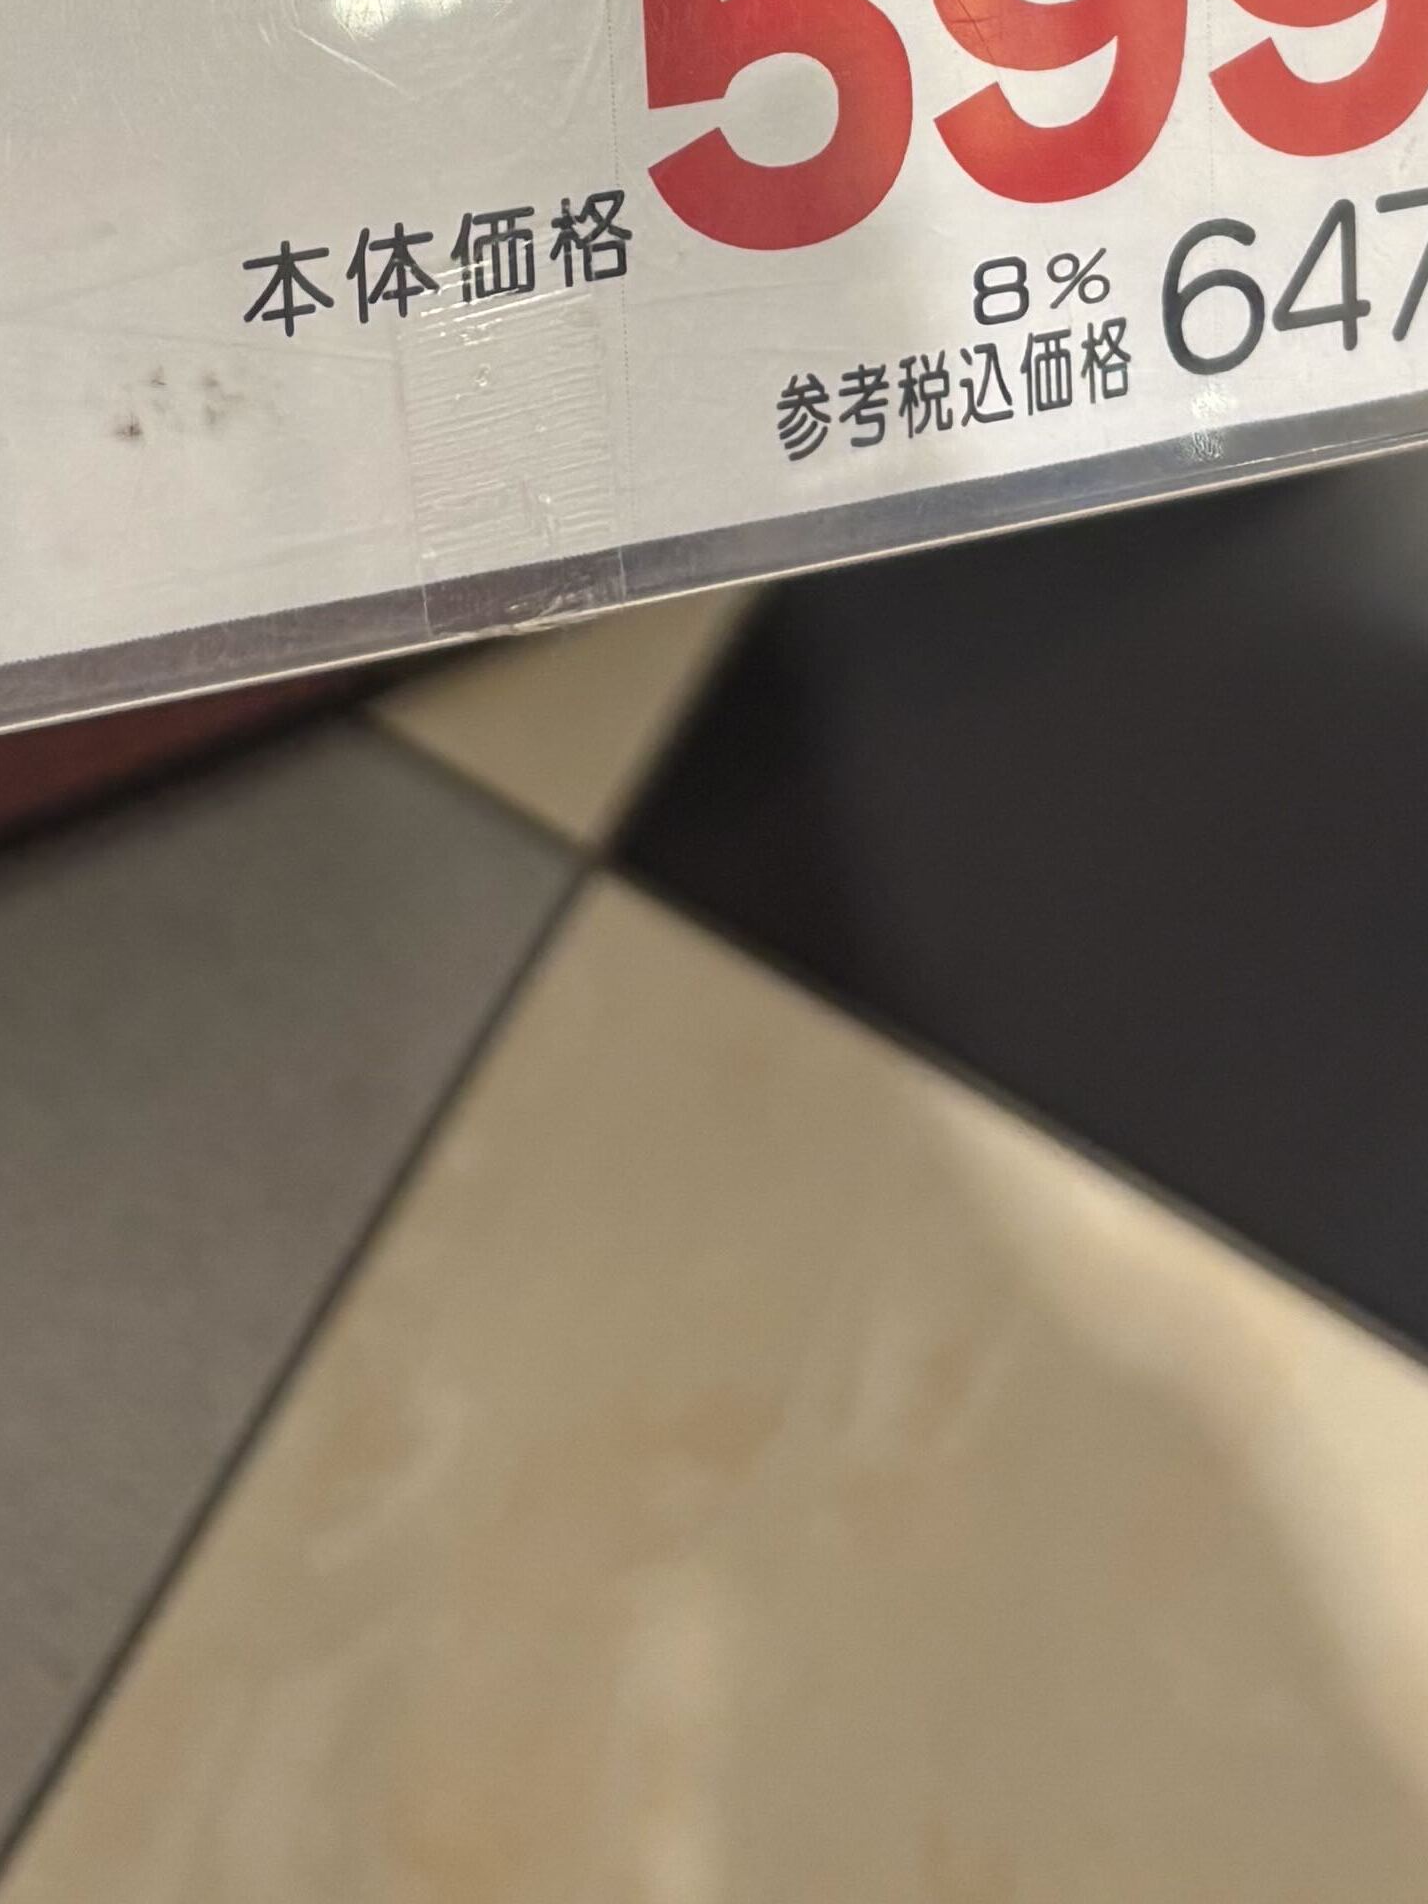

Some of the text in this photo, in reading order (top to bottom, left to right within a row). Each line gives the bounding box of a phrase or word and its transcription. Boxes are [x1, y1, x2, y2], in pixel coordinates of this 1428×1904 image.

[241, 188, 635, 338] 本体価格
[971, 245, 1111, 327] 8%
[774, 315, 1132, 462] 参考税込価格
